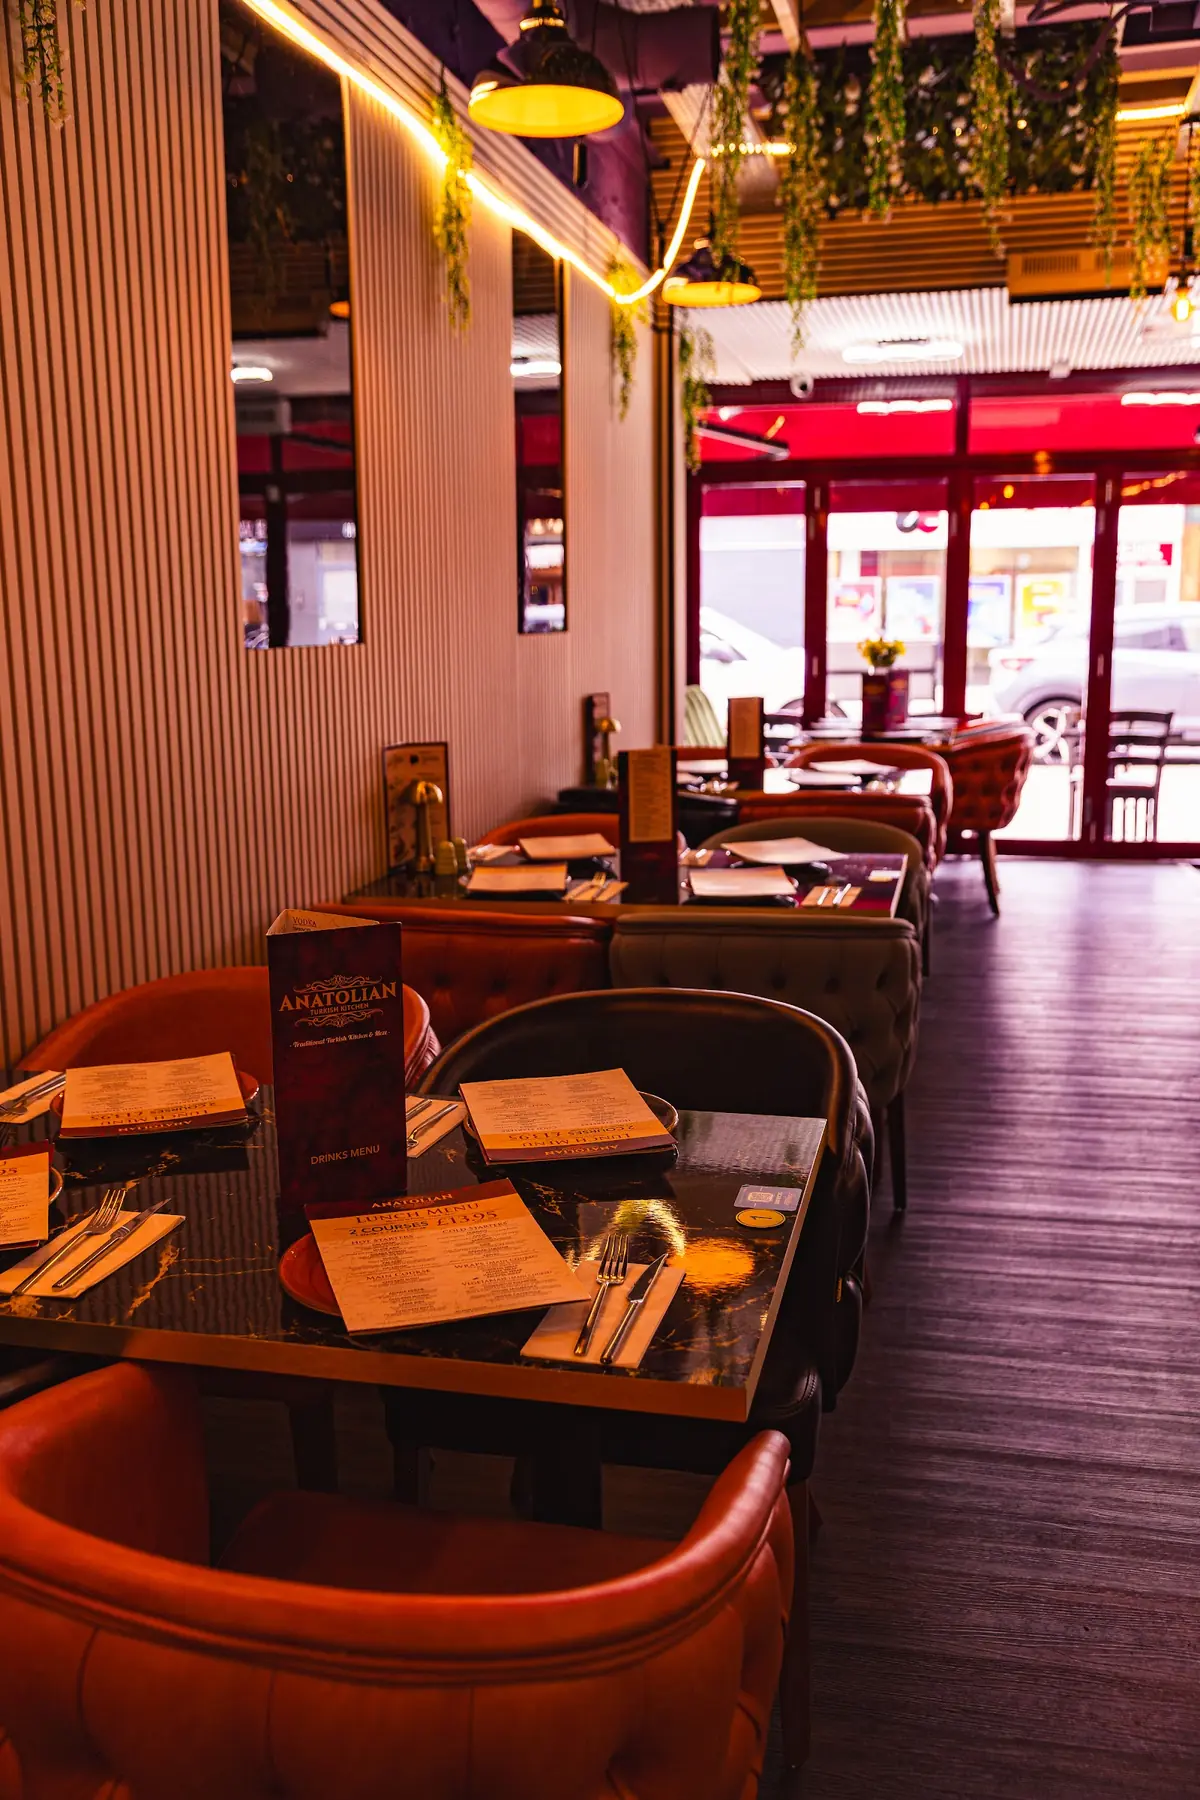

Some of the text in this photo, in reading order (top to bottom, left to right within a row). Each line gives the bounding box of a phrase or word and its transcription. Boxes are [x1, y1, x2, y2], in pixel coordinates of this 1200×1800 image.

[279, 981, 397, 1012] ANATOLIAN
[310, 1002, 369, 1016] TURKISH KITCHEN
[326, 1035, 347, 1044] Turkish
[567, 1126, 626, 1136] COURSES
[575, 1133, 630, 1143] LUNCH
[310, 1144, 380, 1165] DRINKS MENU
[544, 1144, 618, 1156] ANATOLIAN
[371, 1193, 453, 1208] ANATOLIAN
[356, 1202, 479, 1224] LUNCH MENU
[361, 1221, 429, 1233] COURSES
[468, 1221, 508, 1230] STARTERS
